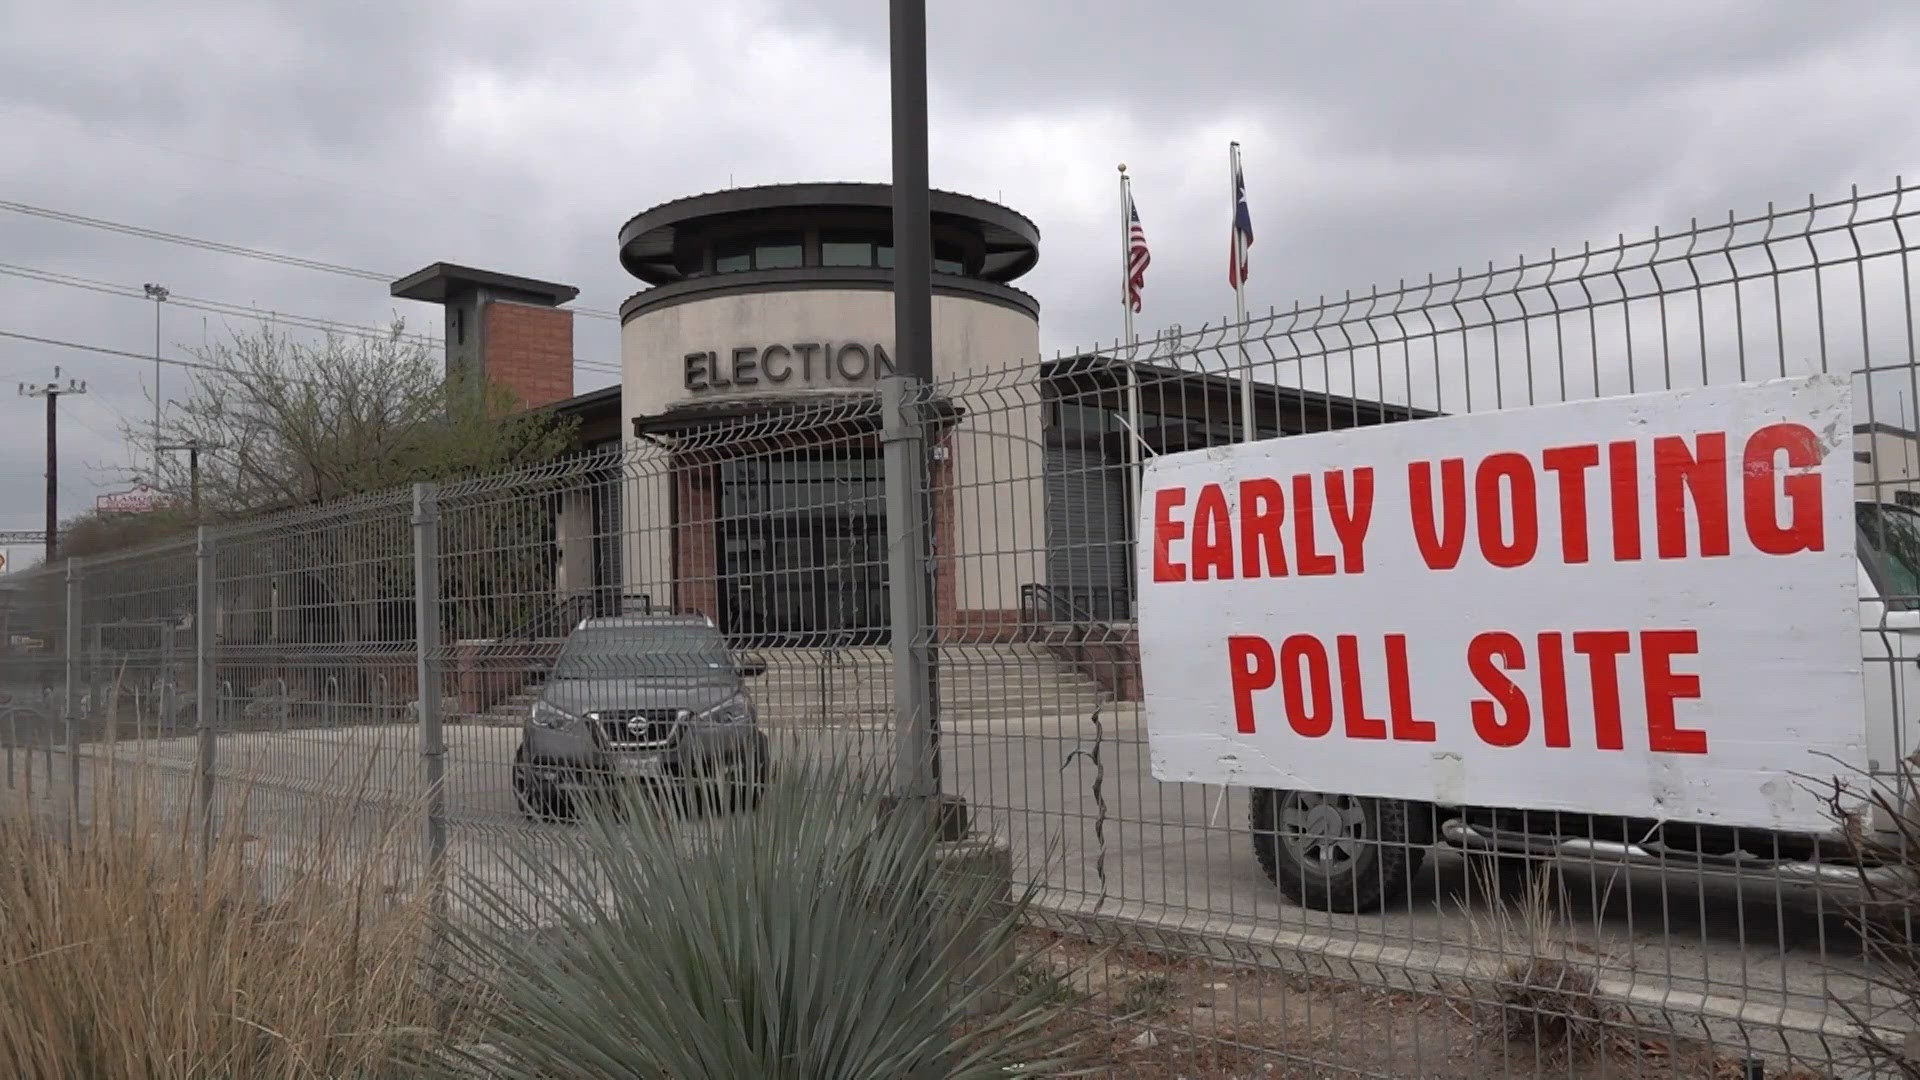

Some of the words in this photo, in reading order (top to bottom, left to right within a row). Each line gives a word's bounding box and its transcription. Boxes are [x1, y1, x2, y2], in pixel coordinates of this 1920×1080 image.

[1153, 466, 1374, 583] EARLY
[1408, 423, 1825, 570] VOTING
[1228, 633, 1436, 742] POLL
[1467, 630, 1707, 754] SITE
